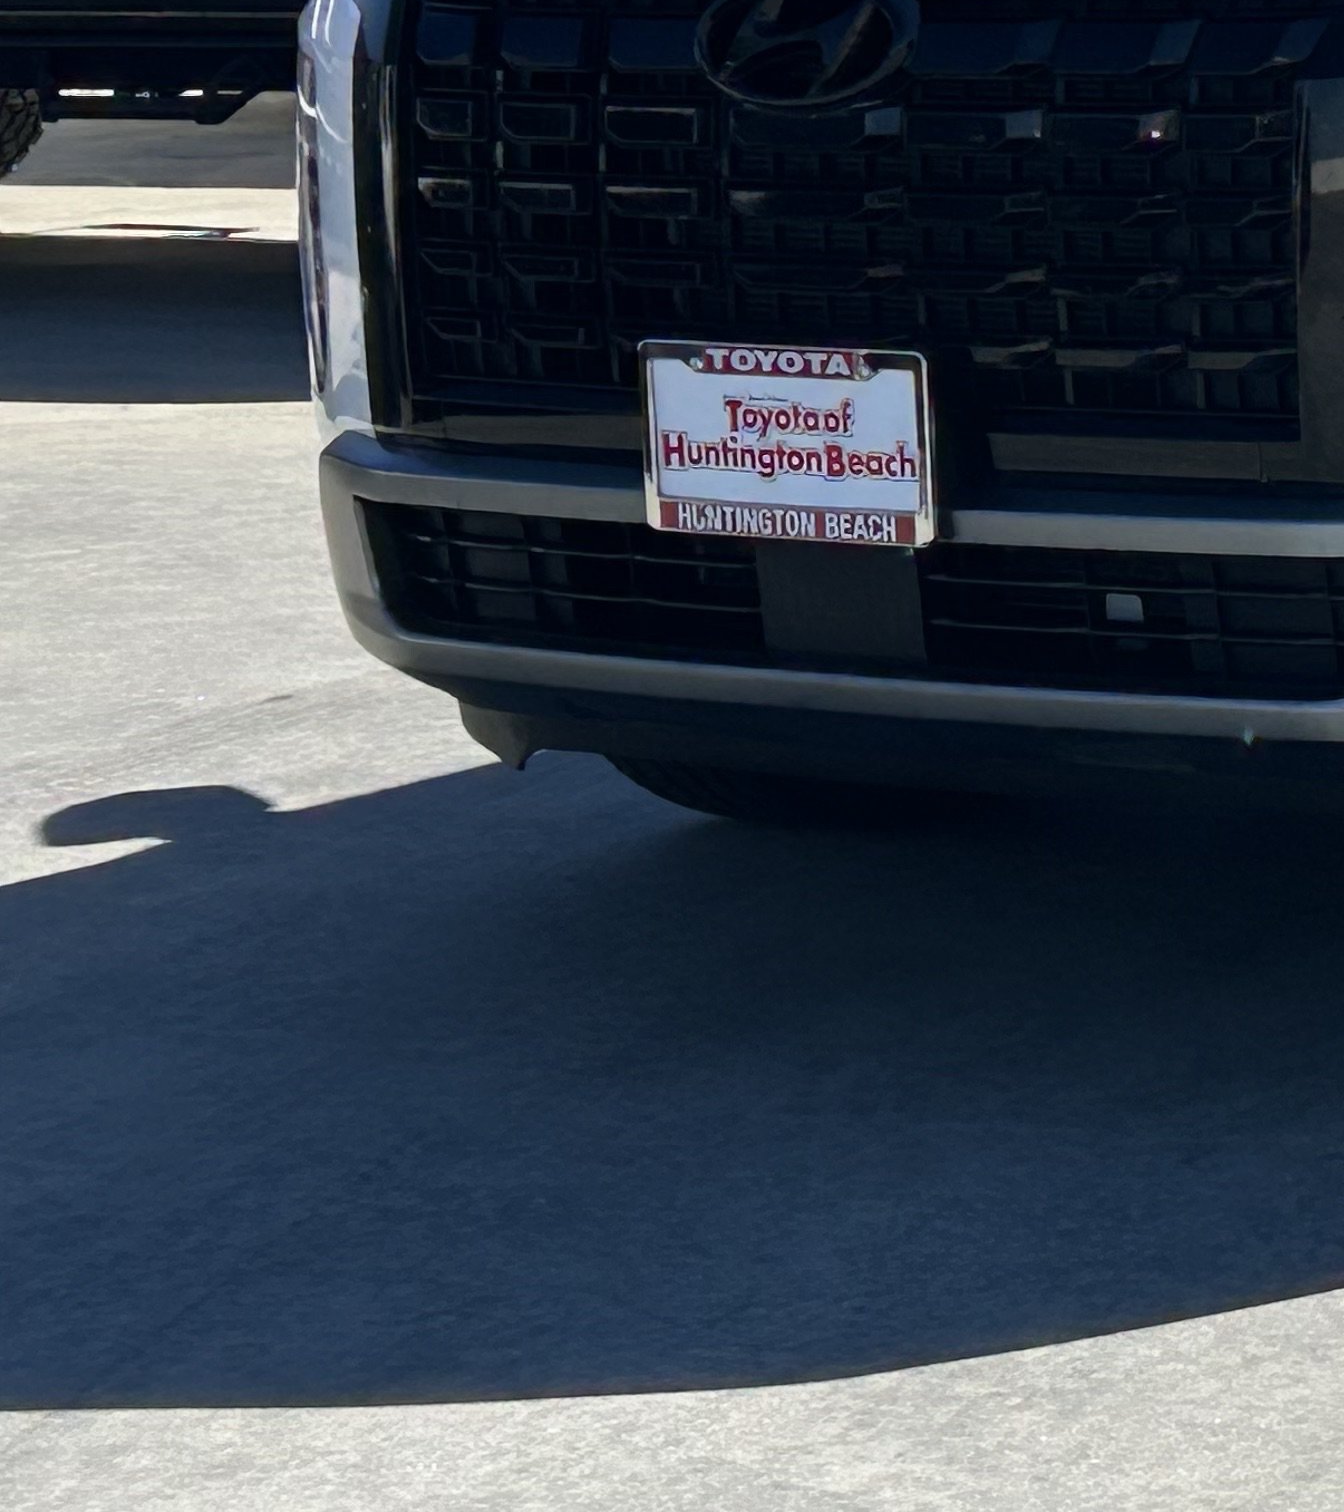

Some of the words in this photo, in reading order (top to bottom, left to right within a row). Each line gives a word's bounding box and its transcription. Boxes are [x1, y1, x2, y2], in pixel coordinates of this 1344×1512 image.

[705, 347, 852, 376] TOYOTA
[724, 398, 820, 438] Toyota
[823, 398, 855, 434] of
[662, 433, 823, 478] Huntington
[824, 441, 917, 479] Beach
[677, 502, 816, 537] HUNTINGTON
[824, 512, 897, 543] BEACH
